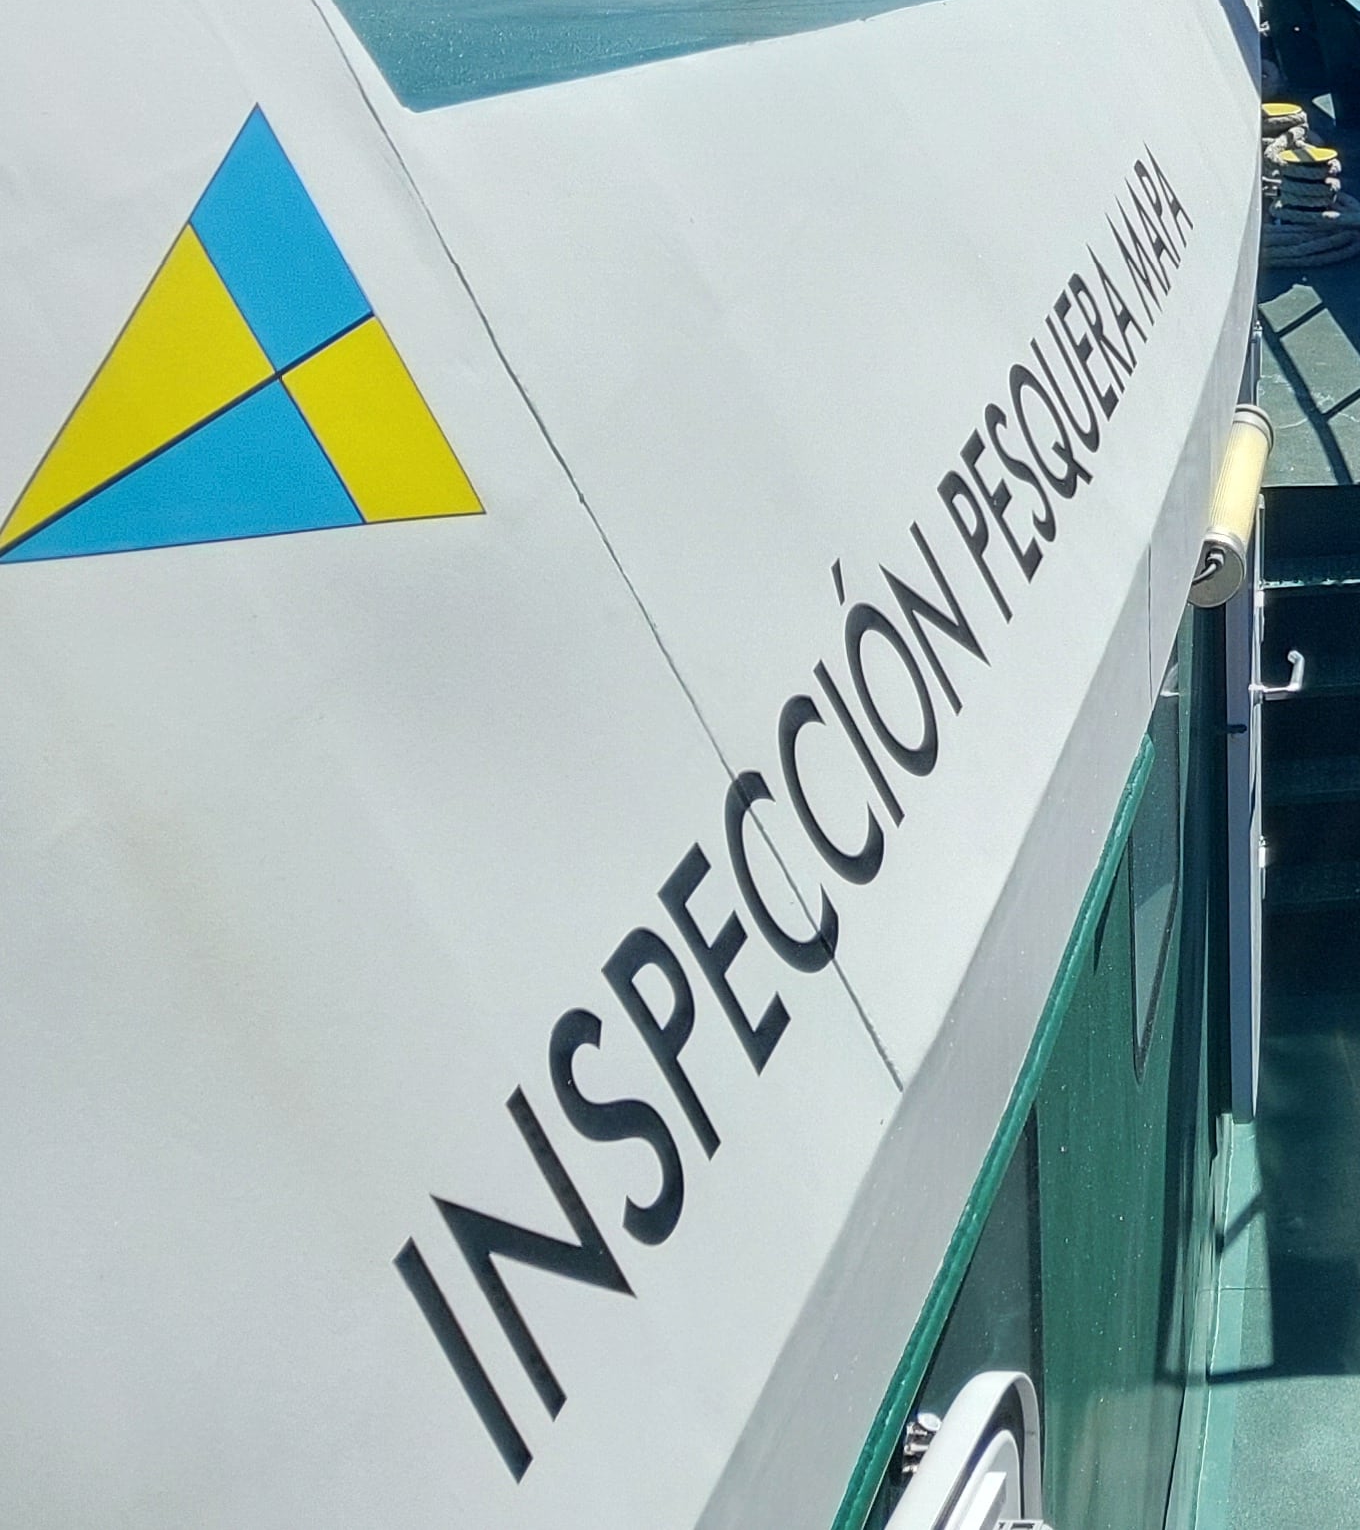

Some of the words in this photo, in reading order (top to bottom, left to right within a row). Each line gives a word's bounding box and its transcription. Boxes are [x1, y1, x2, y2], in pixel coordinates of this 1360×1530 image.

[392, 521, 991, 1485] INSPECCIÓN
[936, 242, 1149, 624] PESQUERA
[1104, 140, 1194, 327] MAPA
